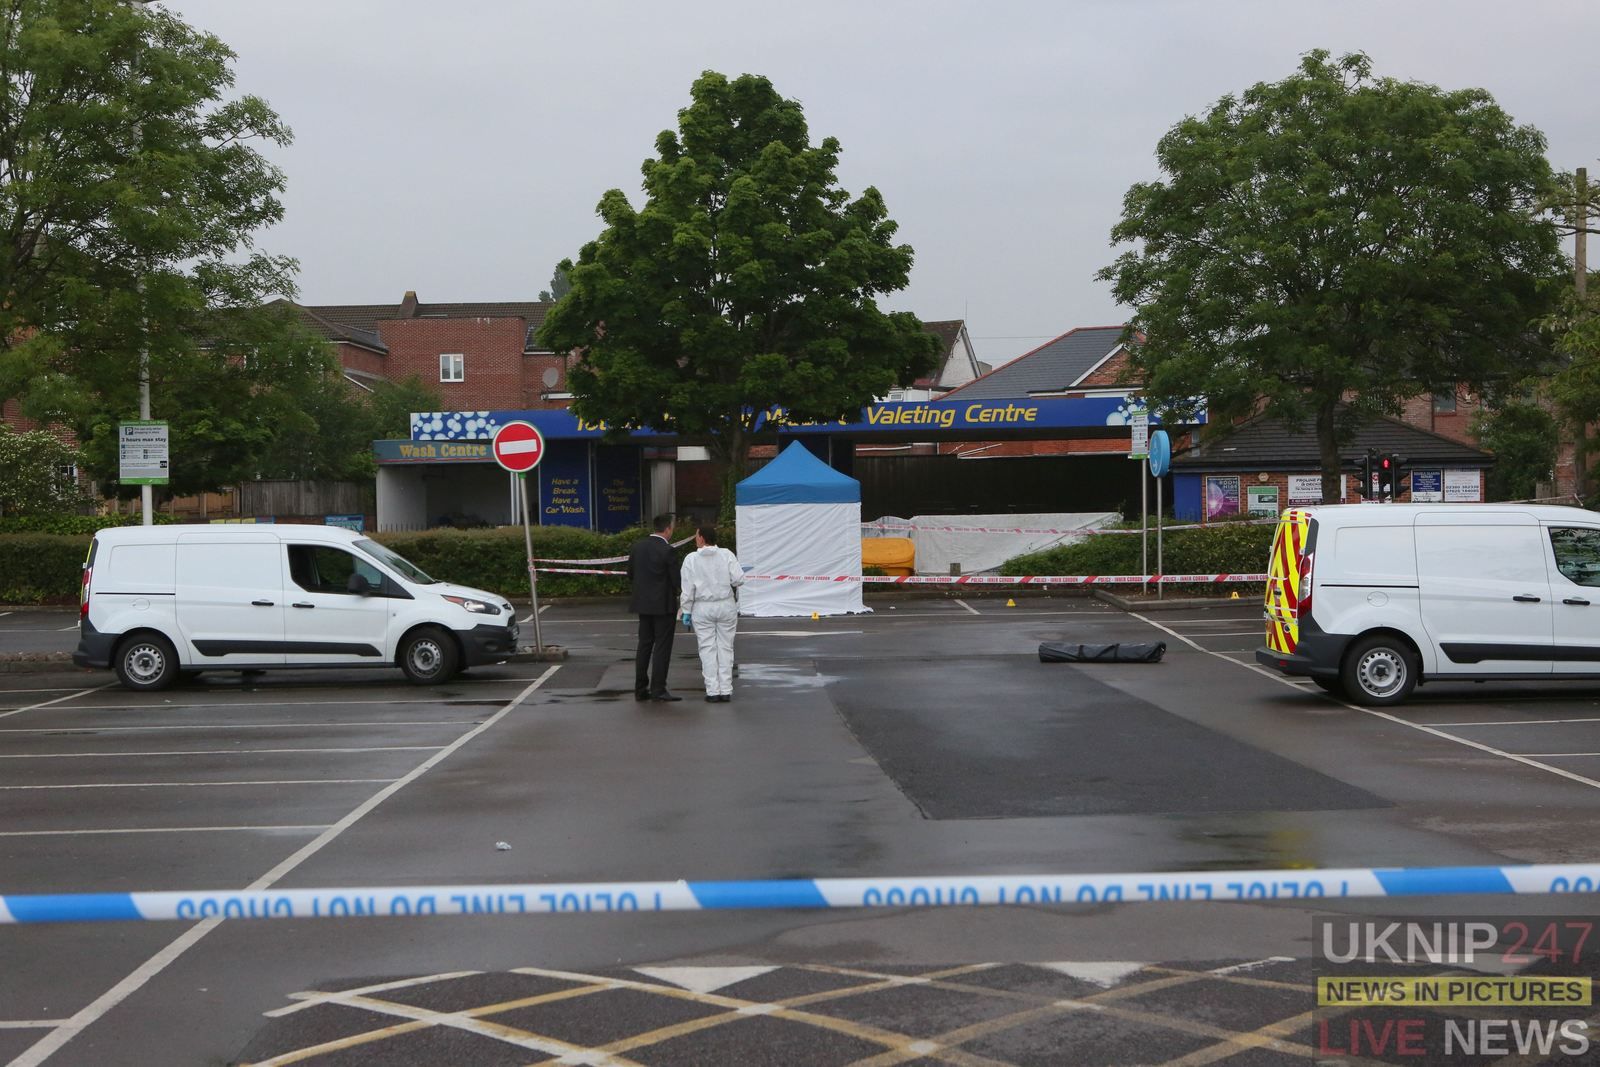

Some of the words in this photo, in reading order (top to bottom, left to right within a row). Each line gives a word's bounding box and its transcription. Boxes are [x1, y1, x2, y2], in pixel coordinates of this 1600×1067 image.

[867, 405, 955, 427] Valeting
[965, 404, 1038, 423] Centre
[400, 444, 436, 458] Wash
[440, 443, 487, 458] Centre
[553, 487, 577, 495] Break
[545, 506, 559, 514] Car
[561, 505, 585, 513] Wash
